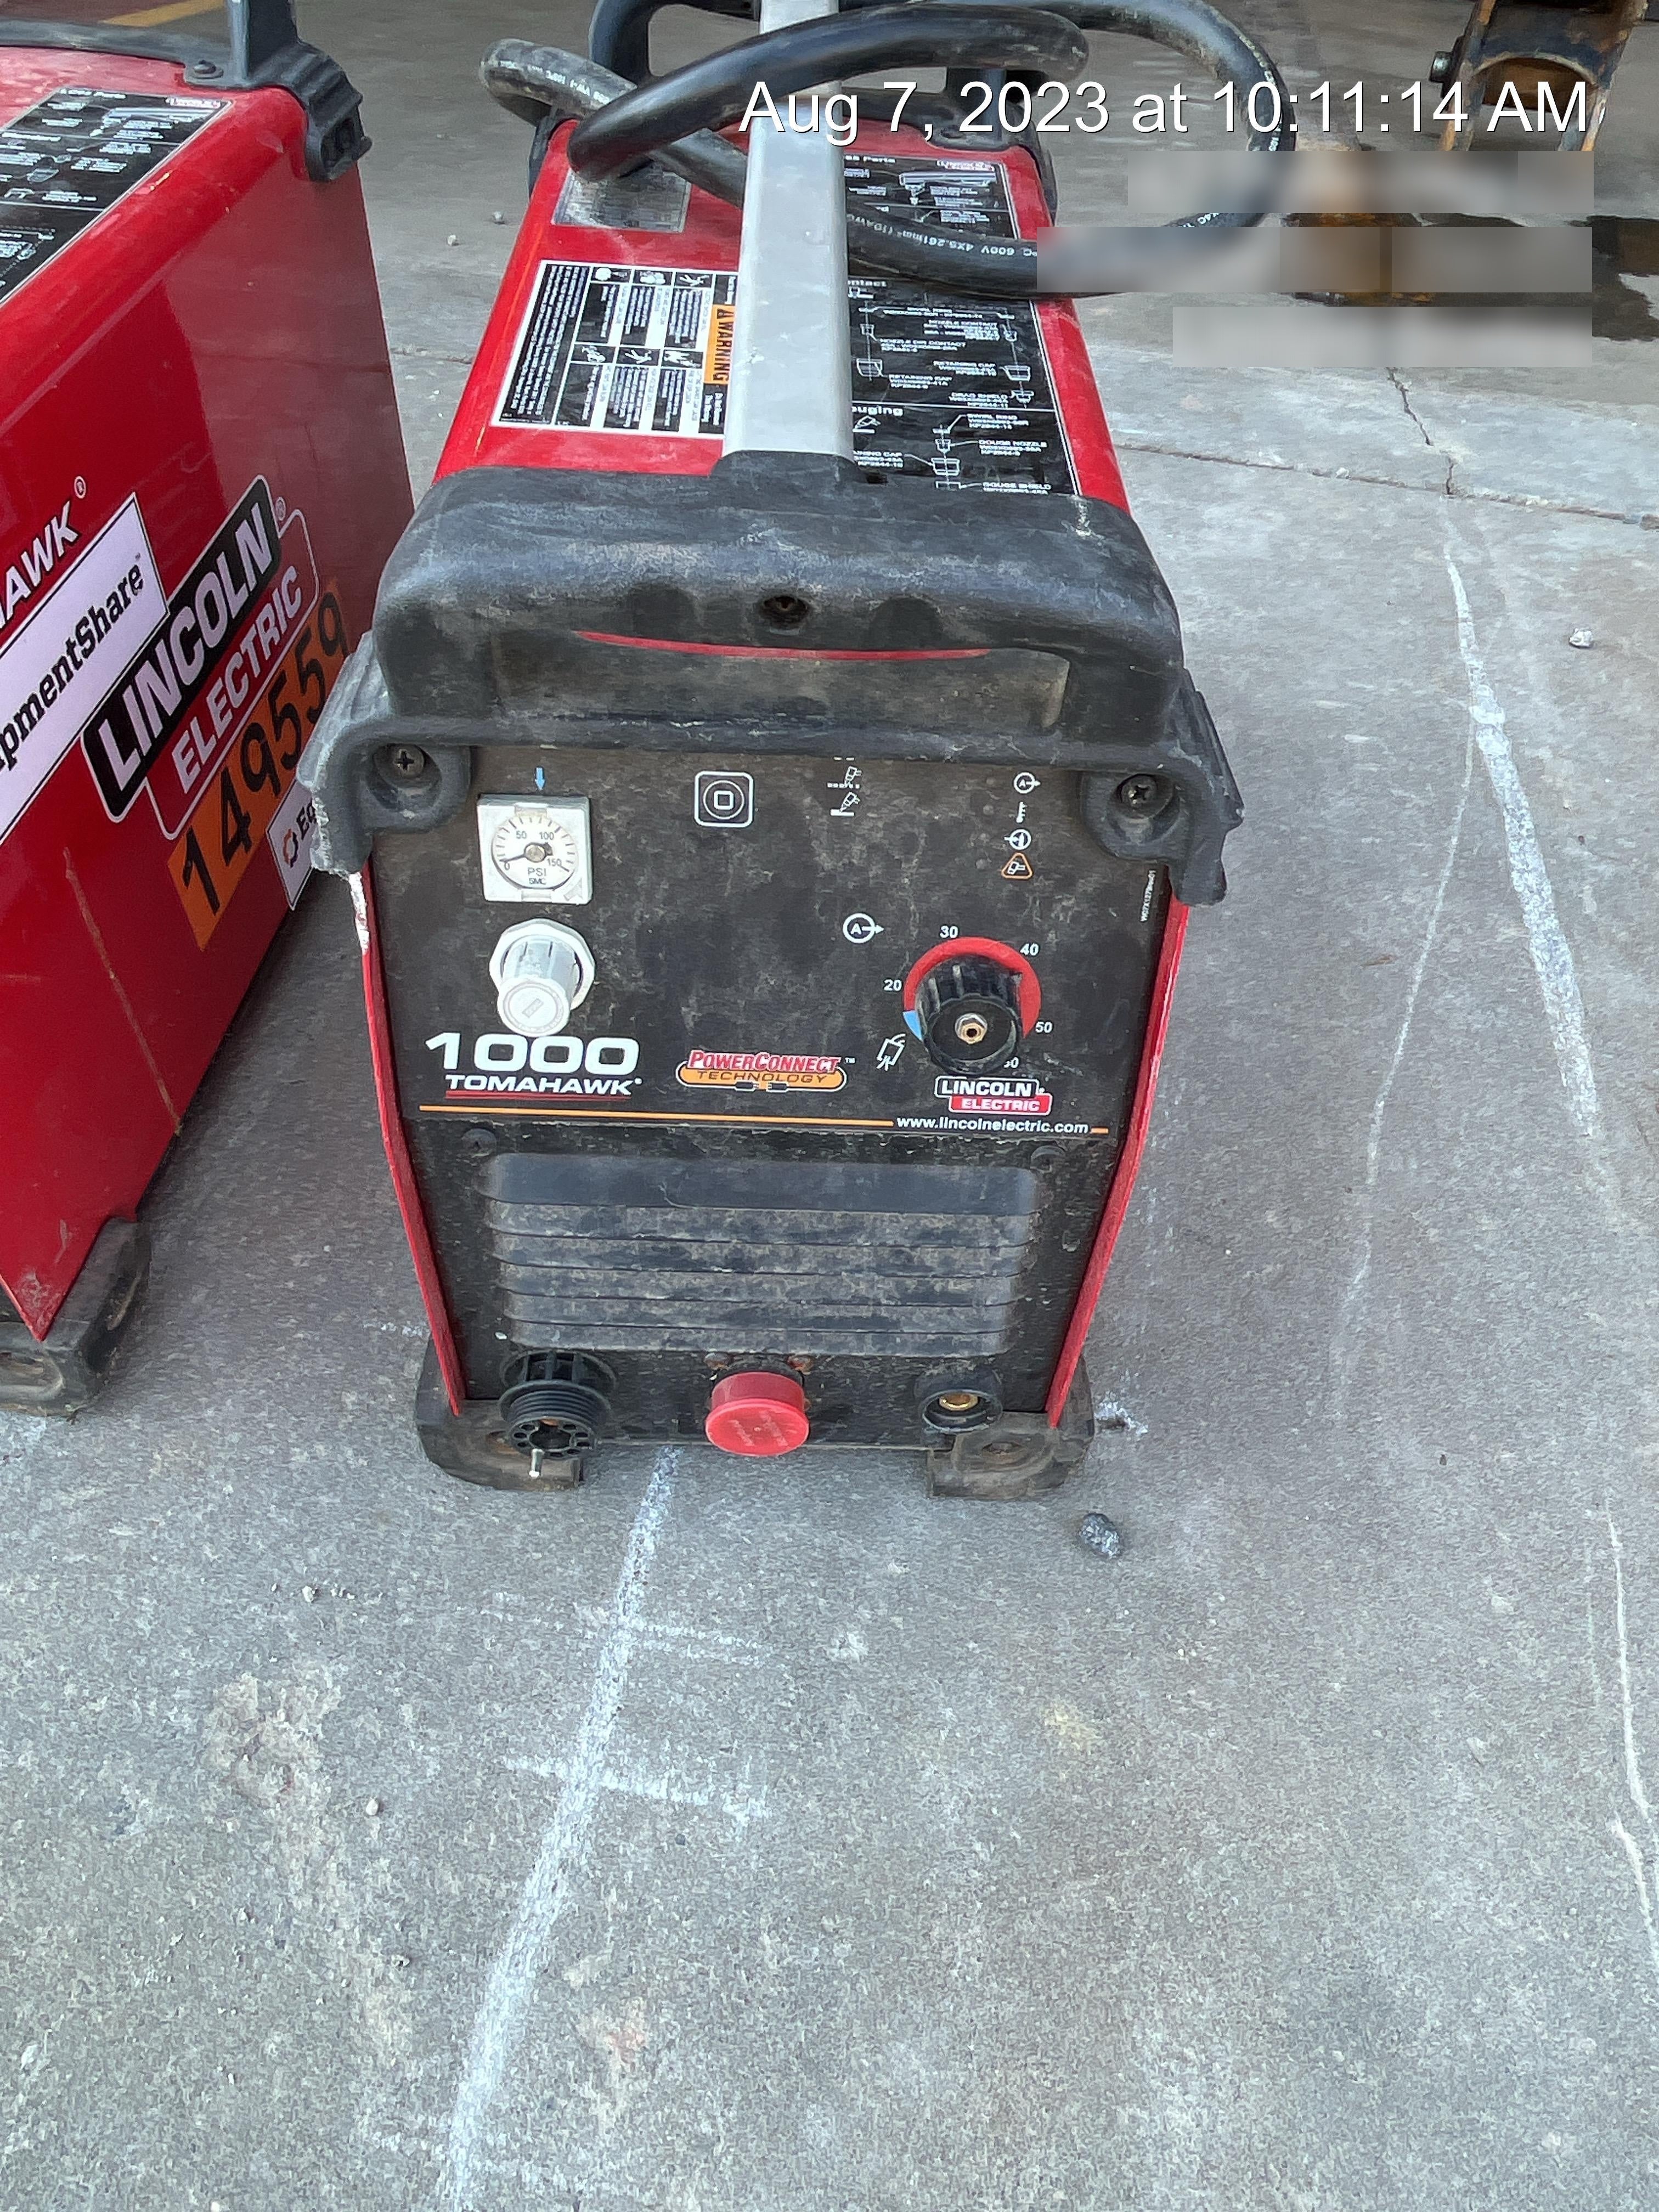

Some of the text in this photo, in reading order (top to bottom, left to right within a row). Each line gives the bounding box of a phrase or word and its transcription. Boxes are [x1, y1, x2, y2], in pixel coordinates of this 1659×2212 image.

[981, 245, 1015, 256] 600V
[713, 320, 735, 382] WARNING
[0, 500, 79, 629] AWK
[99, 502, 274, 792] LINCOLN
[0, 563, 144, 771] pmentShare
[172, 565, 302, 794] ELECTRIC
[182, 591, 352, 916] 149559
[516, 831, 555, 840] 50 100
[547, 858, 562, 867] 150
[527, 867, 547, 877] PSI
[940, 926, 958, 938] 30
[1020, 943, 1040, 956] 40
[883, 978, 902, 992] 20
[1035, 1021, 1053, 1034] 50
[425, 1031, 640, 1076] 1000
[697, 1070, 827, 1084] TECHNOLOGY
[941, 1079, 1032, 1097] LINCOLN
[961, 1098, 1041, 1111] ELECTRIC
[896, 1115, 1090, 1134] www.lincolnelectric.com
